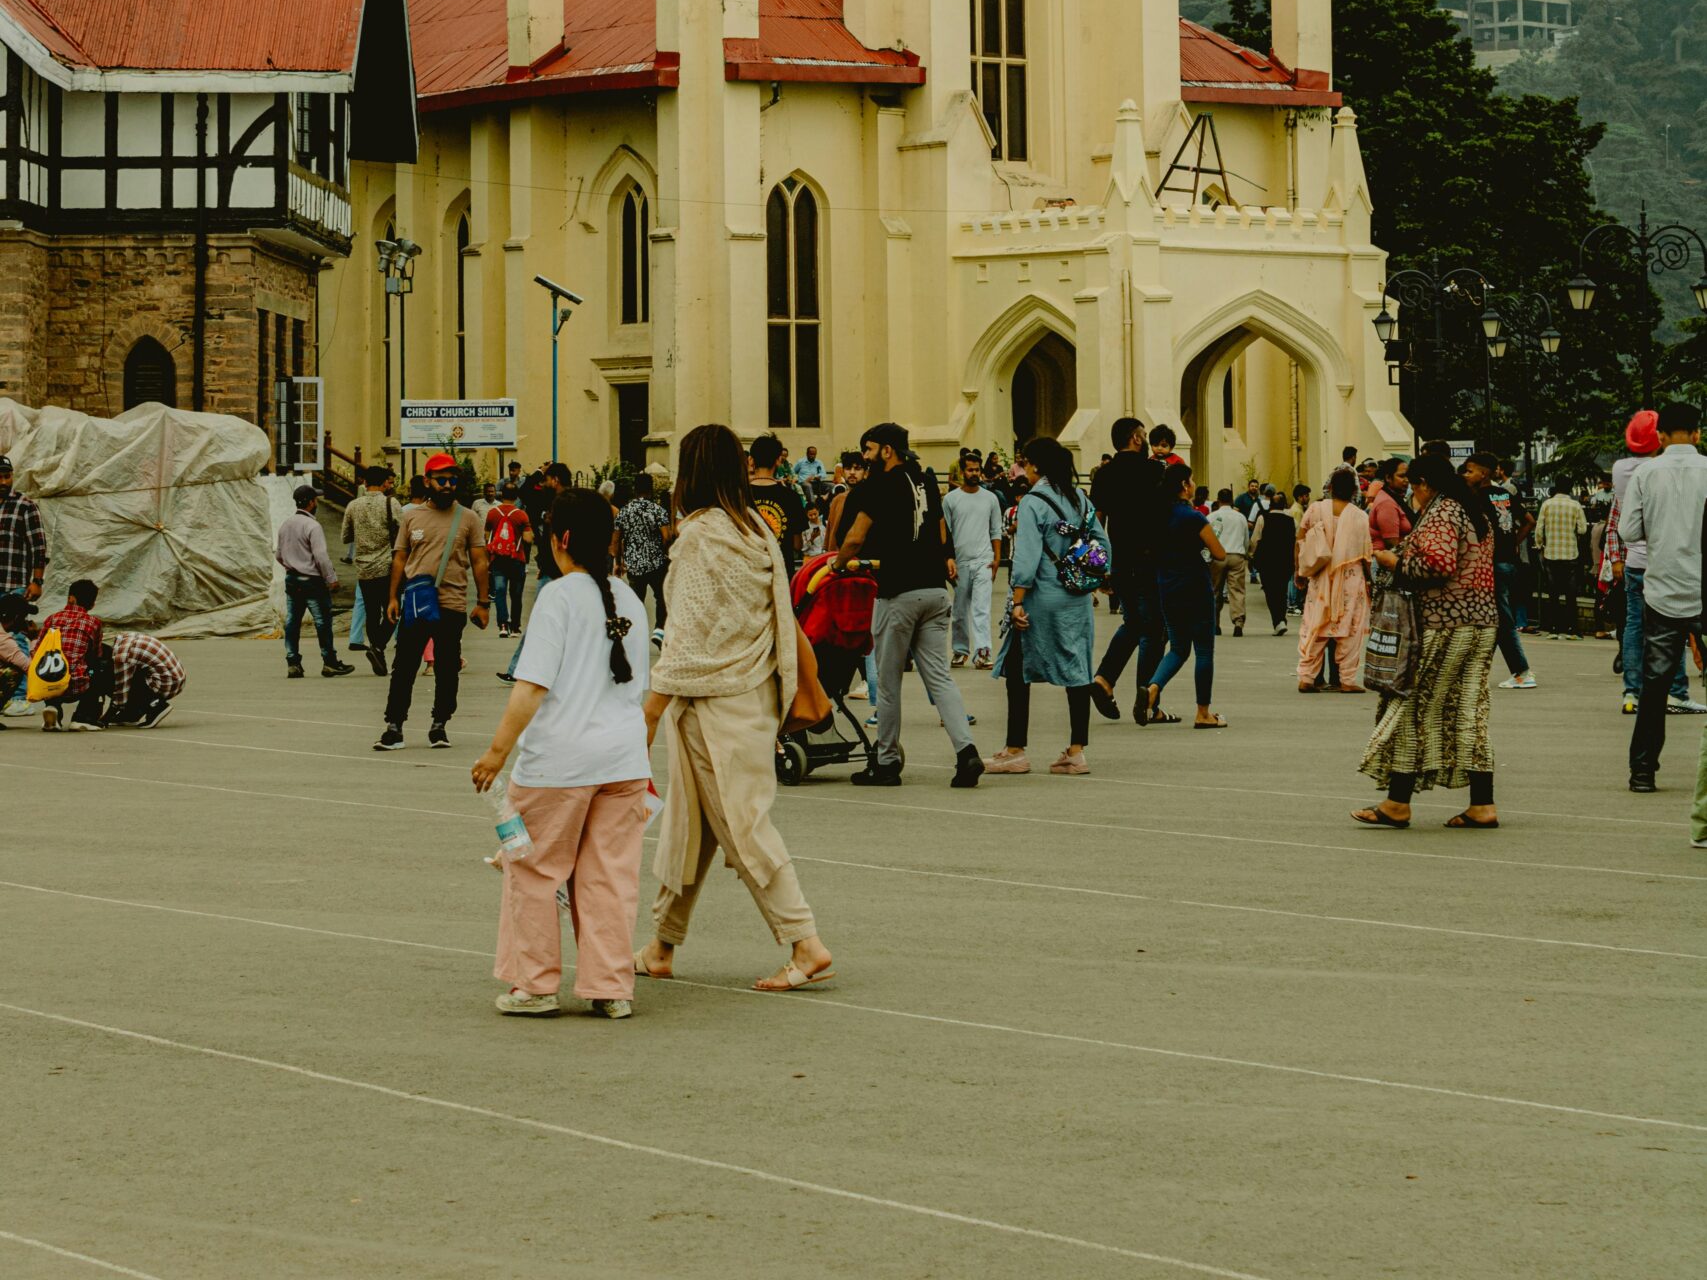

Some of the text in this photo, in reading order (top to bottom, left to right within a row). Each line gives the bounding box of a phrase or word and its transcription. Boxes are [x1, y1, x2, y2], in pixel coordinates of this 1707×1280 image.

[406, 407, 509, 417] CHRIST CHURCH SHIMLA
[38, 652, 65, 675] JD
